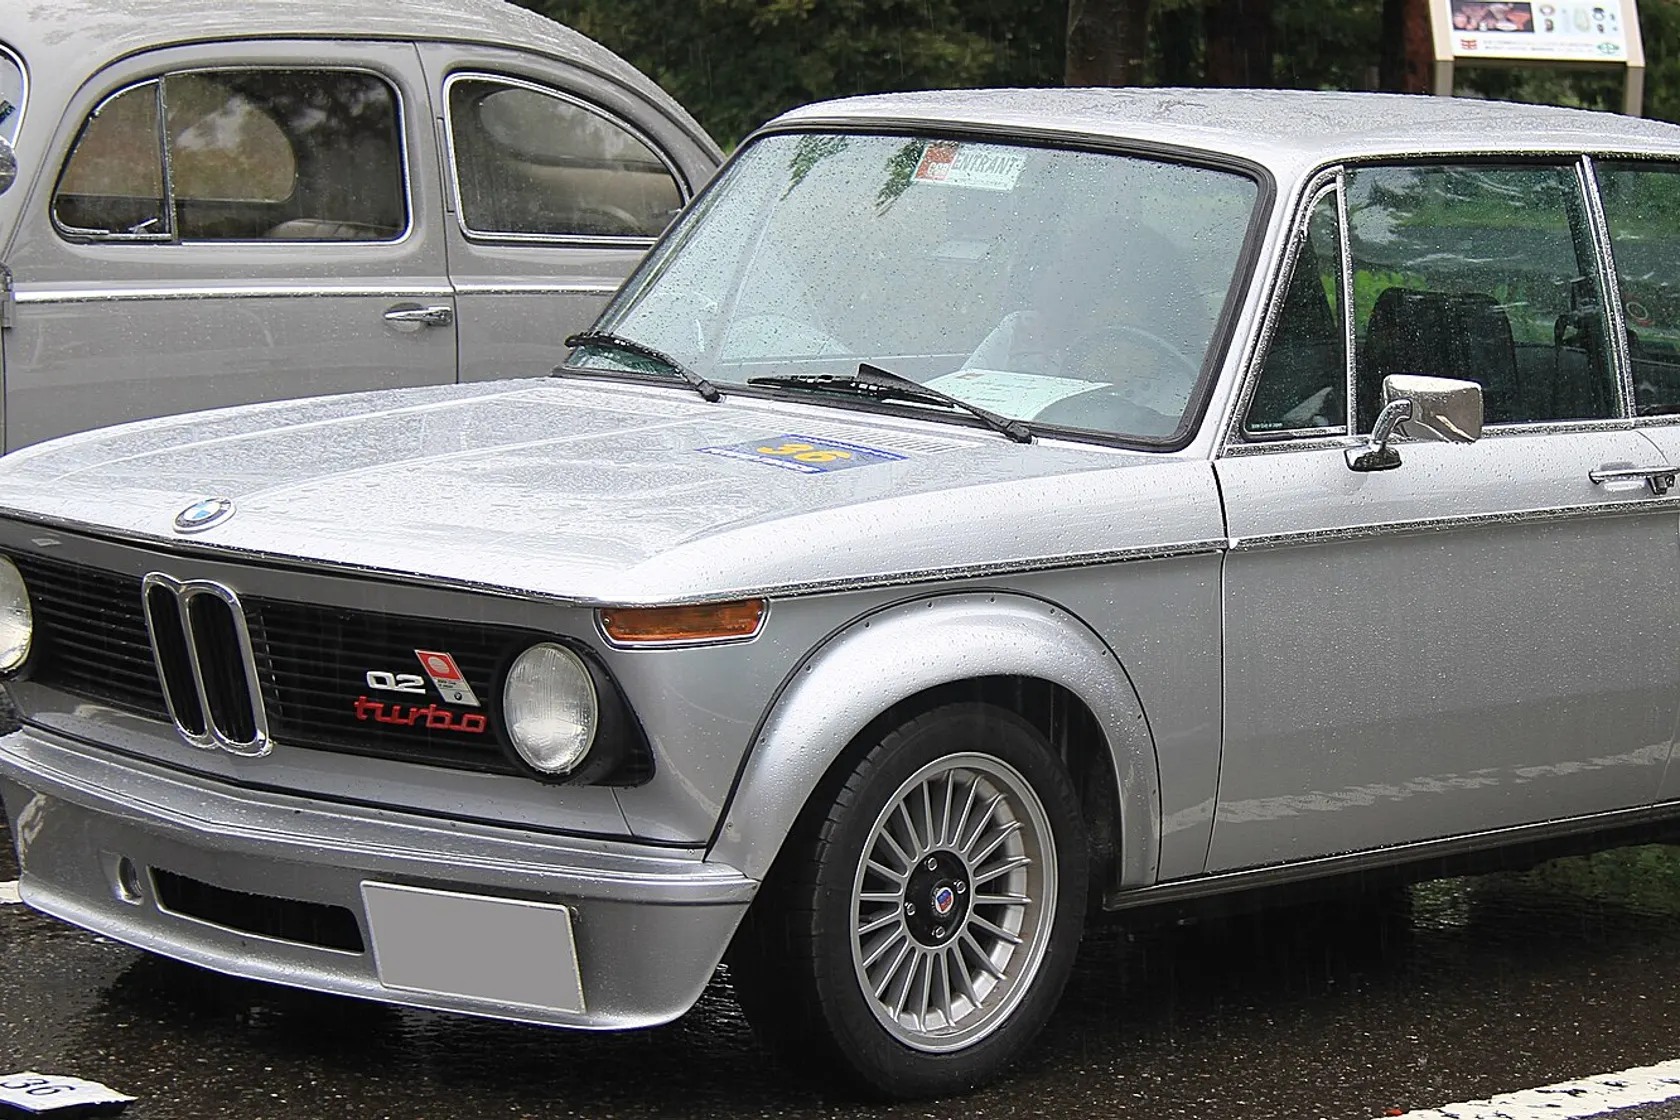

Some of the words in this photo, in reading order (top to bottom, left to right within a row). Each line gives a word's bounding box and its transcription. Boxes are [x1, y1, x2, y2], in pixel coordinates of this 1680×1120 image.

[366, 670, 426, 694] 02
[354, 696, 486, 732] turbo
[0, 1078, 76, 1096] 36
